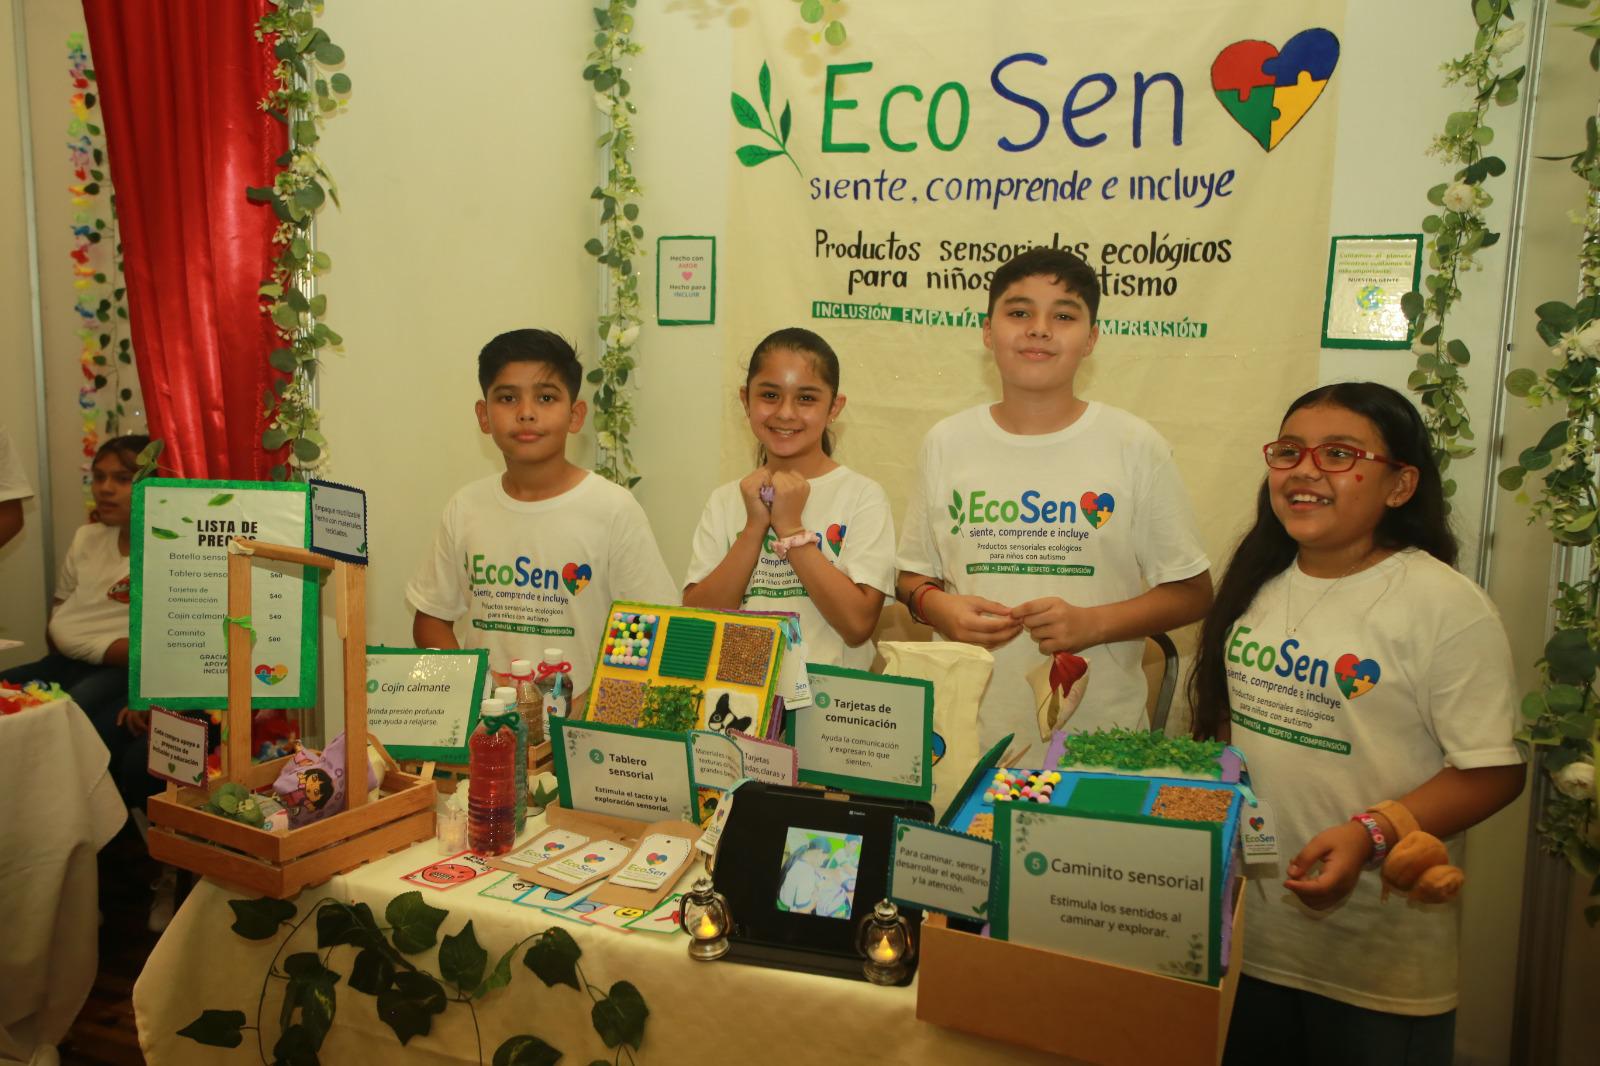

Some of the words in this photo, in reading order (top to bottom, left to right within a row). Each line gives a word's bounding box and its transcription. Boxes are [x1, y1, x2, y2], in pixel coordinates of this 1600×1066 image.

[926, 170, 1092, 210] comprende
[1101, 175, 1119, 200] e
[1129, 168, 1236, 208] incluye
[815, 229, 921, 261] Productos
[939, 232, 1089, 263] sensoriles
[1101, 231, 1232, 271] ecológicos
[848, 268, 908, 296] para
[927, 268, 995, 292] niños
[1099, 267, 1178, 297] tismo
[815, 302, 893, 321] INCLUSIÓN
[902, 307, 983, 329] EMPATÍA
[1099, 318, 1202, 338] MPRENSIÓN
[969, 490, 1077, 524] EcoSen
[197, 519, 236, 533] LISTA
[241, 521, 258, 534] DE
[969, 527, 996, 538] siente,
[998, 527, 1048, 540] comprende
[1058, 528, 1089, 541] incluye
[198, 534, 257, 547] PREC
[1048, 543, 1082, 553] ecológicos
[989, 552, 1005, 560] para
[1006, 552, 1023, 560] niños
[1039, 553, 1066, 561] autismo
[169, 569, 202, 578] Tablero
[472, 554, 559, 590] EcoSen
[542, 594, 569, 605] incluye
[191, 612, 226, 620] calmant
[1227, 625, 1329, 688] EcoSen
[381, 682, 405, 695] Cojín
[406, 683, 451, 692] calmante
[1250, 676, 1298, 697] comprende
[1306, 689, 1341, 709] incluye
[833, 698, 876, 712] Tarjetas
[878, 703, 892, 713] de
[382, 718, 402, 727] ayuda
[825, 713, 897, 730] comunicación
[1269, 712, 1282, 721] con
[1283, 717, 1313, 730] autismo
[180, 738, 196, 748] apoya
[820, 733, 842, 744] Ayuda
[843, 735, 850, 743] la
[851, 737, 900, 750] comunicación
[1299, 735, 1348, 752] COMPRENSIÓN
[608, 752, 647, 767] Tablero
[745, 752, 770, 765] Tarjetas
[829, 745, 834, 753] y
[835, 746, 867, 757] expresan
[867, 749, 875, 757] lo
[876, 751, 890, 760] que
[845, 757, 873, 768] sienten.
[608, 767, 654, 781] sensorial
[594, 785, 626, 797] Estimula
[627, 790, 633, 798] el
[634, 790, 652, 801] tacto
[653, 794, 659, 803] y
[660, 793, 668, 803] la
[594, 795, 635, 808] exploración
[636, 800, 670, 813] sensorial.
[561, 858, 598, 874] EcoSen
[899, 846, 919, 858] Para
[956, 859, 981, 872] sentir
[981, 867, 987, 876] y
[627, 863, 668, 877] EcoSen
[896, 859, 939, 875] desarrollar
[940, 869, 949, 878] el
[950, 871, 989, 888] equilibrio
[1051, 858, 1124, 881] Caminito
[1127, 869, 1205, 893] sensorial
[912, 876, 918, 886] y
[918, 876, 926, 885] la
[1050, 894, 1098, 912] Estimula
[1099, 900, 1117, 915] los
[1119, 903, 1169, 923] sentidos
[1170, 912, 1182, 924] al
[1059, 913, 1105, 930] caminar
[1107, 919, 1115, 933] y
[1117, 921, 1170, 940] explorar.
